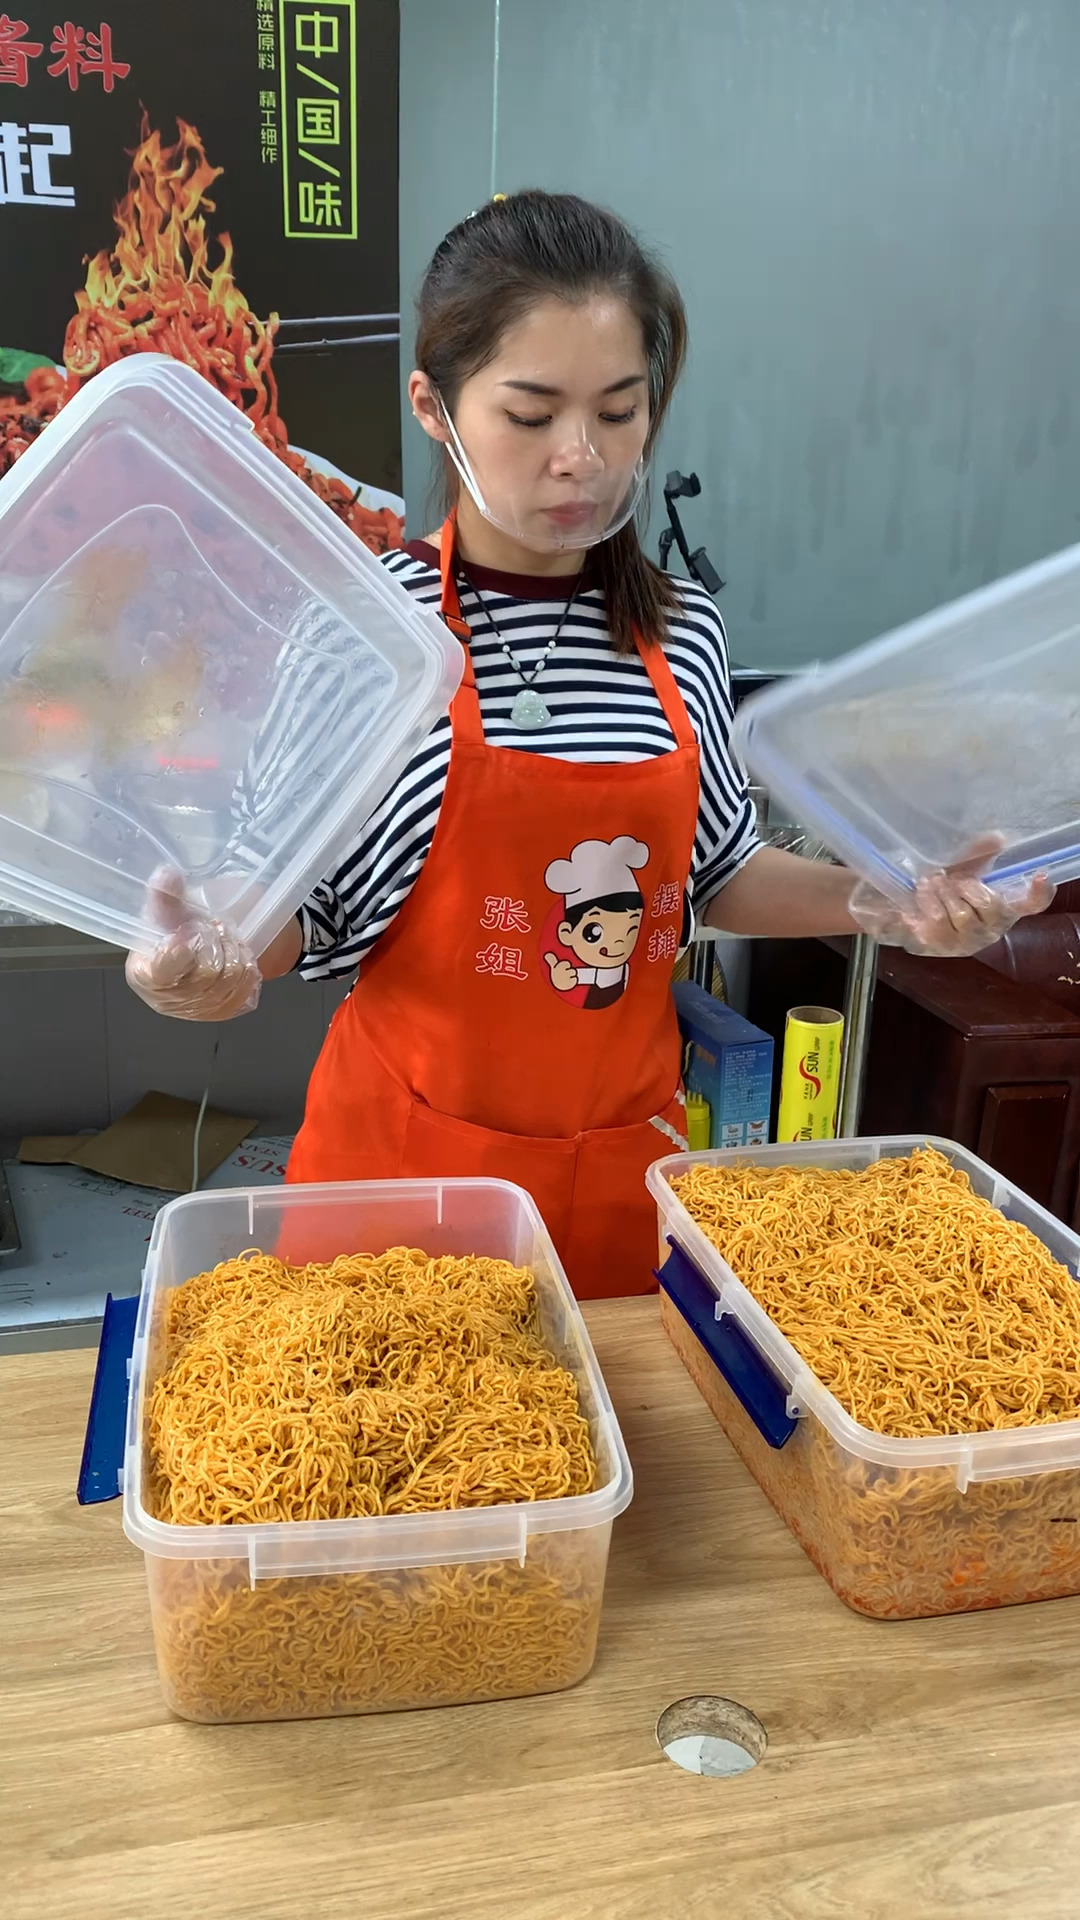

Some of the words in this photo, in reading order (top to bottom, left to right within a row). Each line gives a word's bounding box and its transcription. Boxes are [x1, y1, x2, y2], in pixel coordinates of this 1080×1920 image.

[0, 121, 76, 207] 起
[259, 91, 277, 164] 精工细作
[475, 895, 531, 980] 张姐
[647, 880, 680, 963] 摆摊
[806, 1051, 819, 1073] SUN
[800, 1127, 812, 1142] UN
